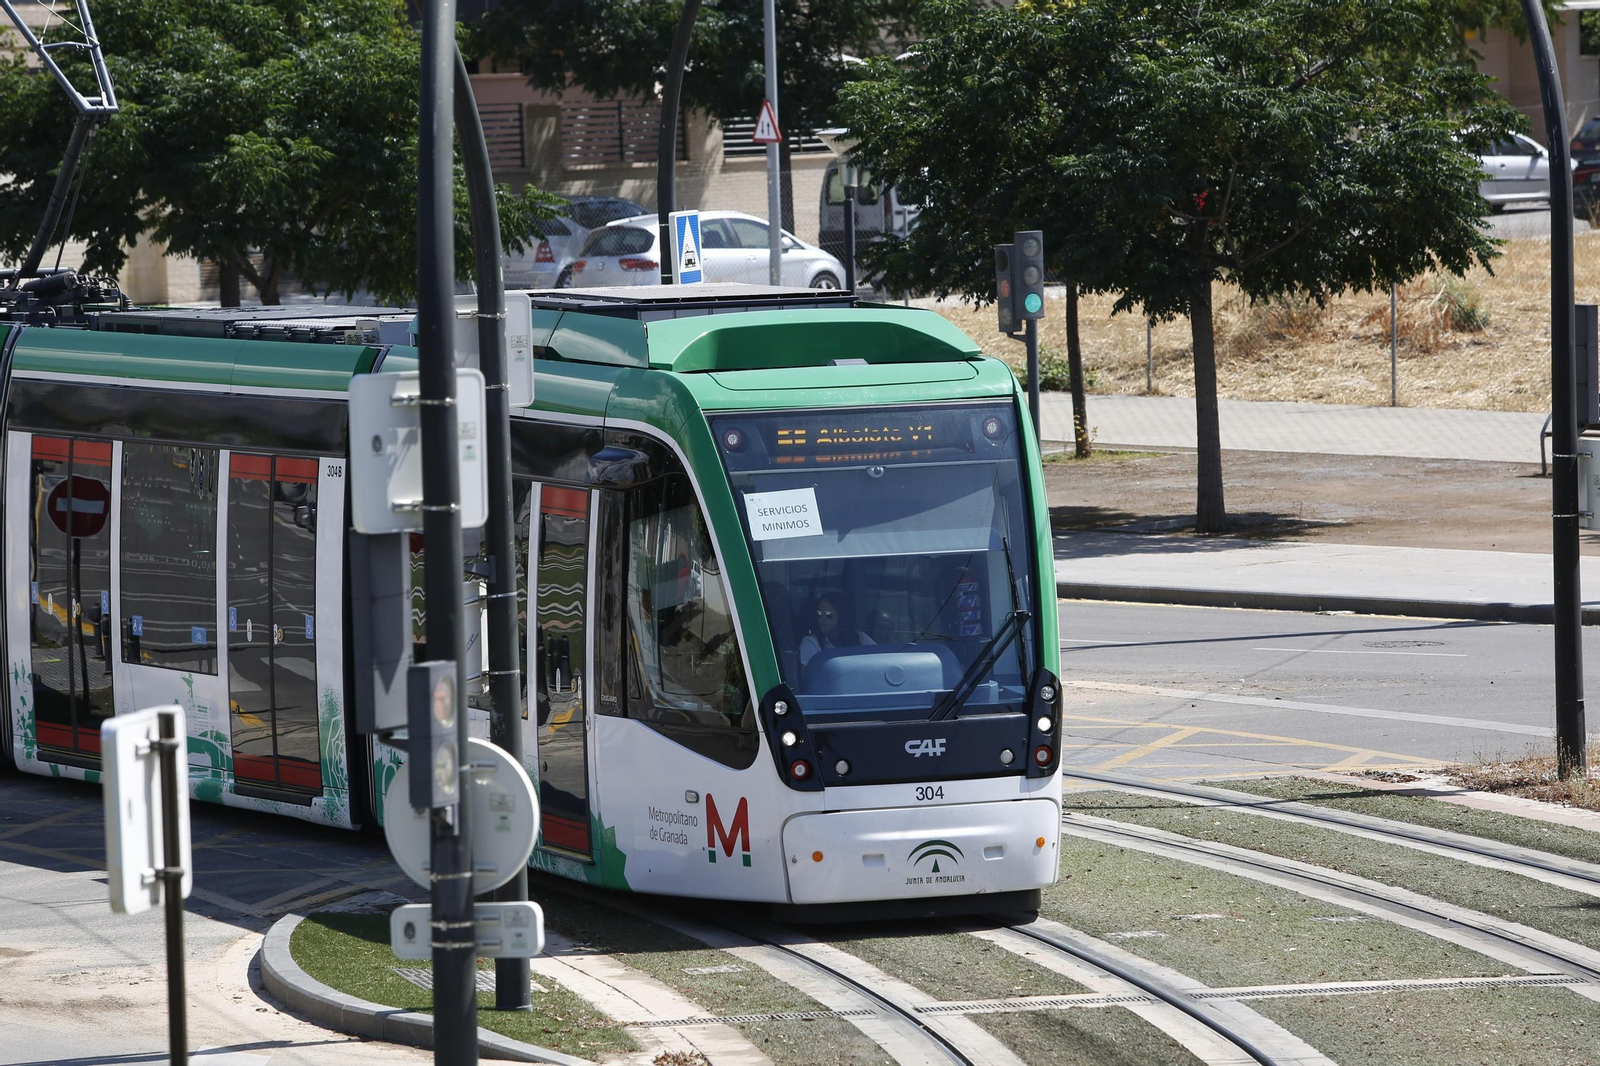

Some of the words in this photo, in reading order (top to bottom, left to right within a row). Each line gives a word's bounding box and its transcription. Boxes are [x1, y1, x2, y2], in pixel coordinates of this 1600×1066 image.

[757, 504, 808, 517] SERVICIOS
[762, 519, 810, 532] MINIMOS
[904, 738, 947, 758] CAF
[915, 785, 944, 801] 304
[648, 806, 698, 827] Metropolitano
[649, 825, 658, 841] de
[659, 826, 688, 845] Granada
[905, 877, 924, 885] JUNTA
[926, 876, 933, 884] DE
